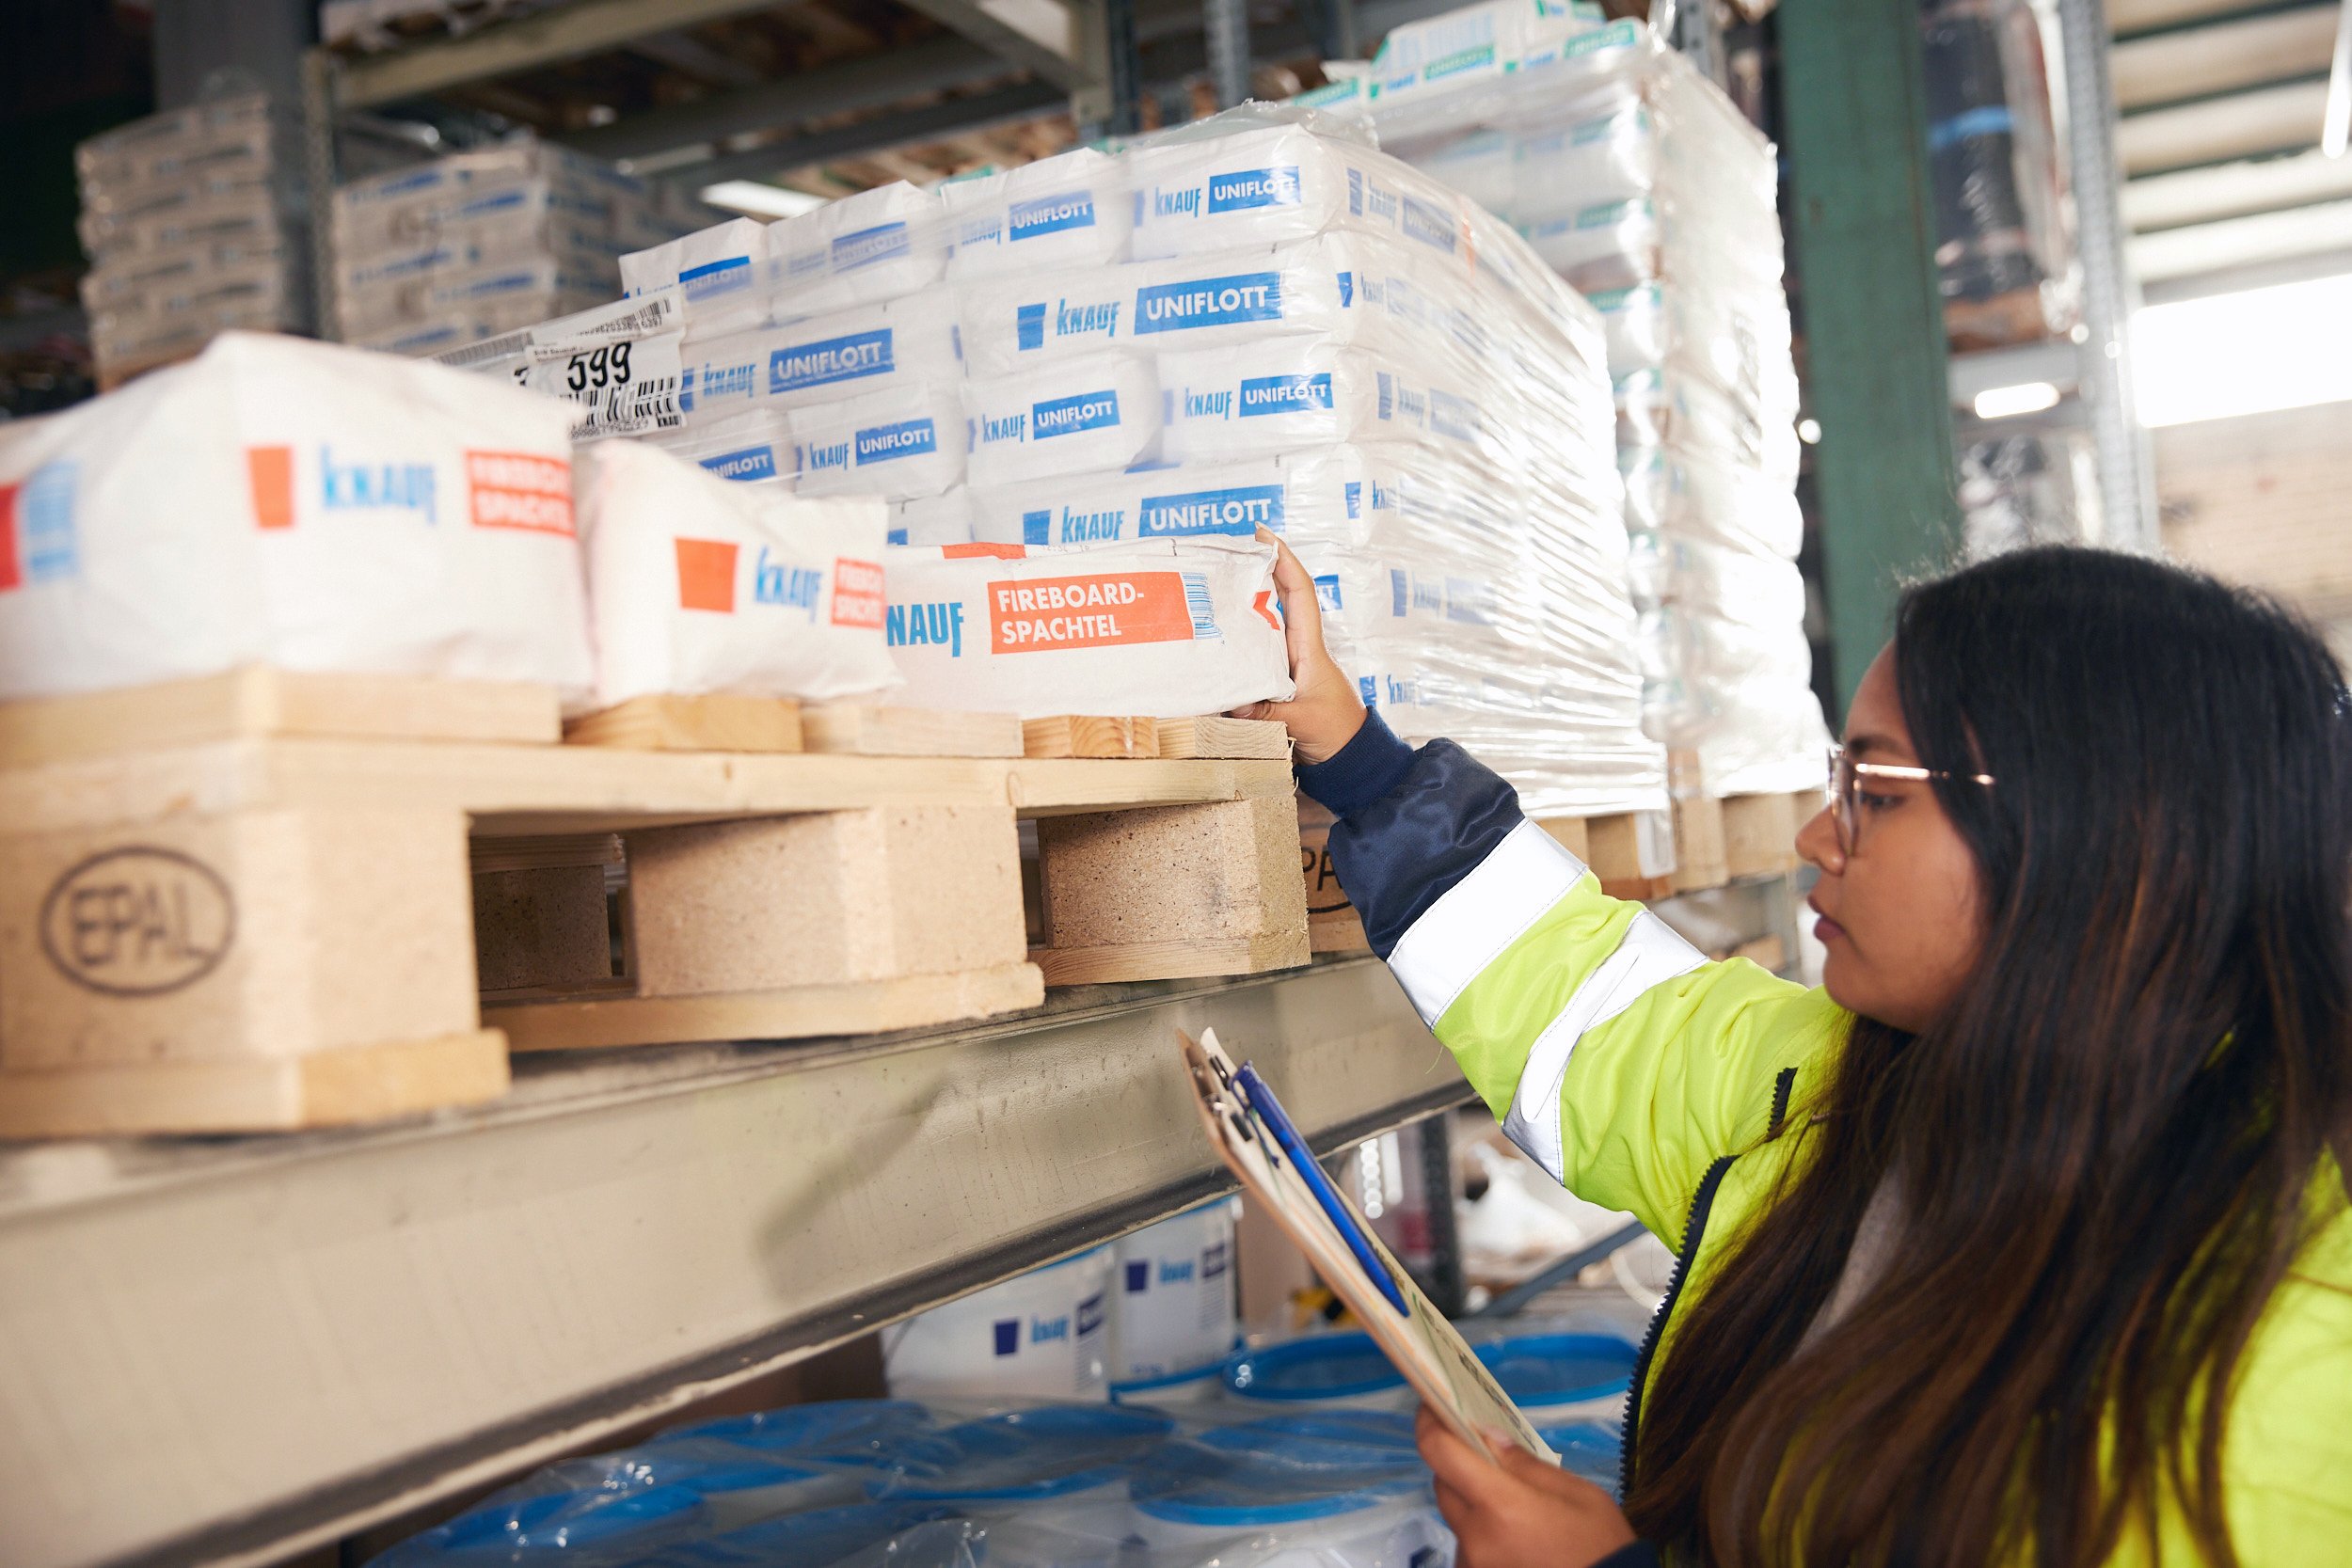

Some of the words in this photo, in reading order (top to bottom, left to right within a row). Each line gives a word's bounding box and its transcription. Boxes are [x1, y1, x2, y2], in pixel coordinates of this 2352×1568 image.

[1014, 200, 1089, 230] UNIFLOTT
[1155, 187, 1200, 217] KNAUF
[1214, 177, 1296, 202] UNIFLOTT
[1057, 298, 1120, 338] KNAUF
[1146, 285, 1269, 322] UNIFLOTT
[568, 341, 632, 391] 599
[777, 341, 882, 380] UNIFLOTT
[1184, 387, 1233, 420] KNAUF
[1245, 381, 1327, 405] UNIFLOTT
[982, 414, 1025, 443] KNAUF
[1038, 401, 1113, 428] UNIFLOTT
[809, 442, 850, 471] KNAUF
[860, 429, 930, 454] UNIFLOTT
[1061, 505, 1124, 544] KNAUF
[1150, 499, 1271, 531] UNIFLOTT
[997, 582, 1144, 612] FIREBOARD-
[887, 602, 964, 657] NAUF
[1001, 614, 1121, 644] SPACHTEL
